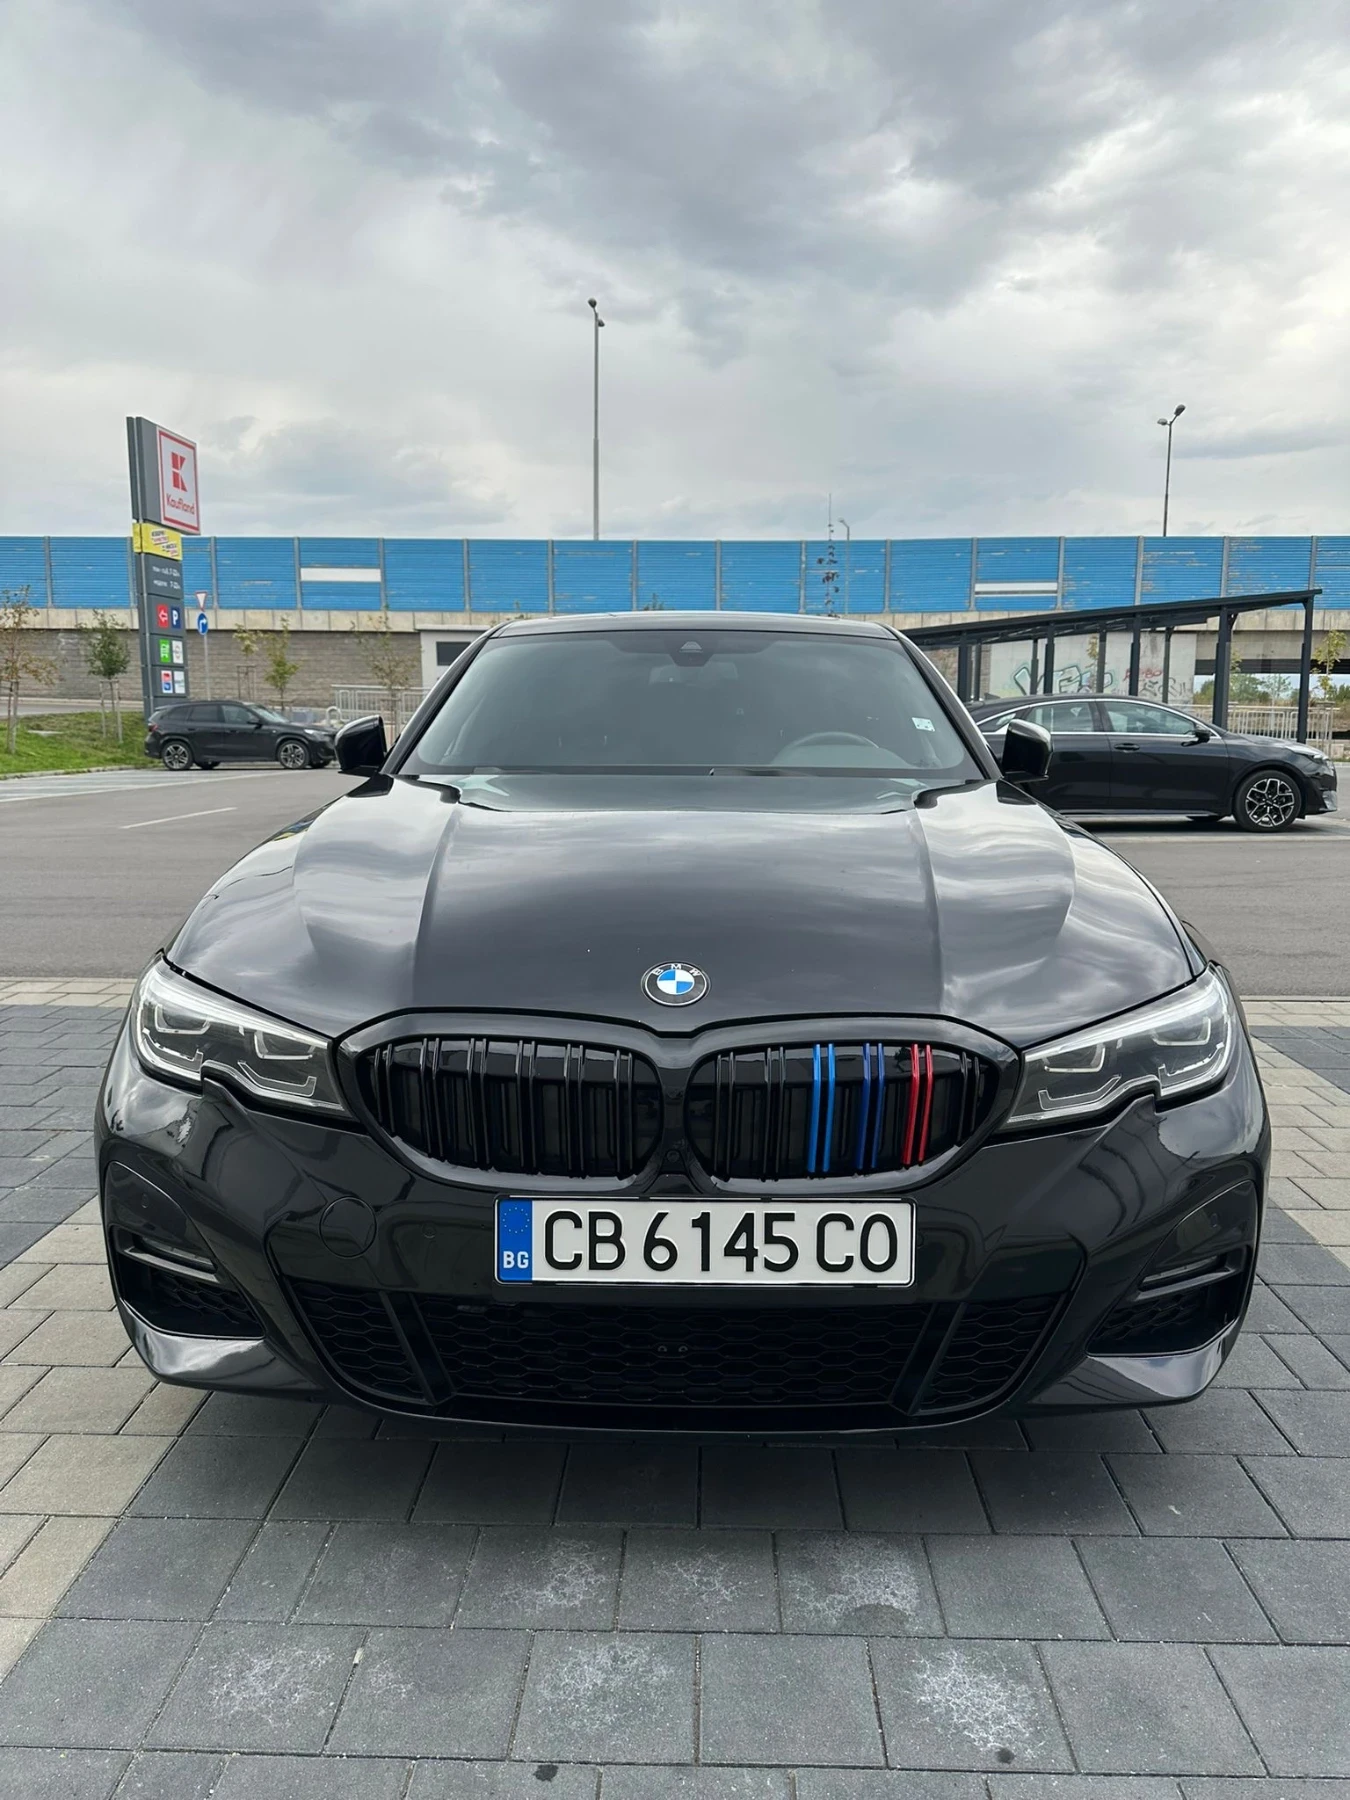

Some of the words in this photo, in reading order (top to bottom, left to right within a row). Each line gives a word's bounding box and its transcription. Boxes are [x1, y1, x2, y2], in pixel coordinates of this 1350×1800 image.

[166, 493, 195, 515] Kaufland
[172, 609, 179, 626] P
[651, 963, 702, 976] BMW
[544, 1210, 626, 1272] CB
[642, 1211, 800, 1273] 6145
[816, 1213, 898, 1273] CO
[502, 1251, 529, 1269] BG
